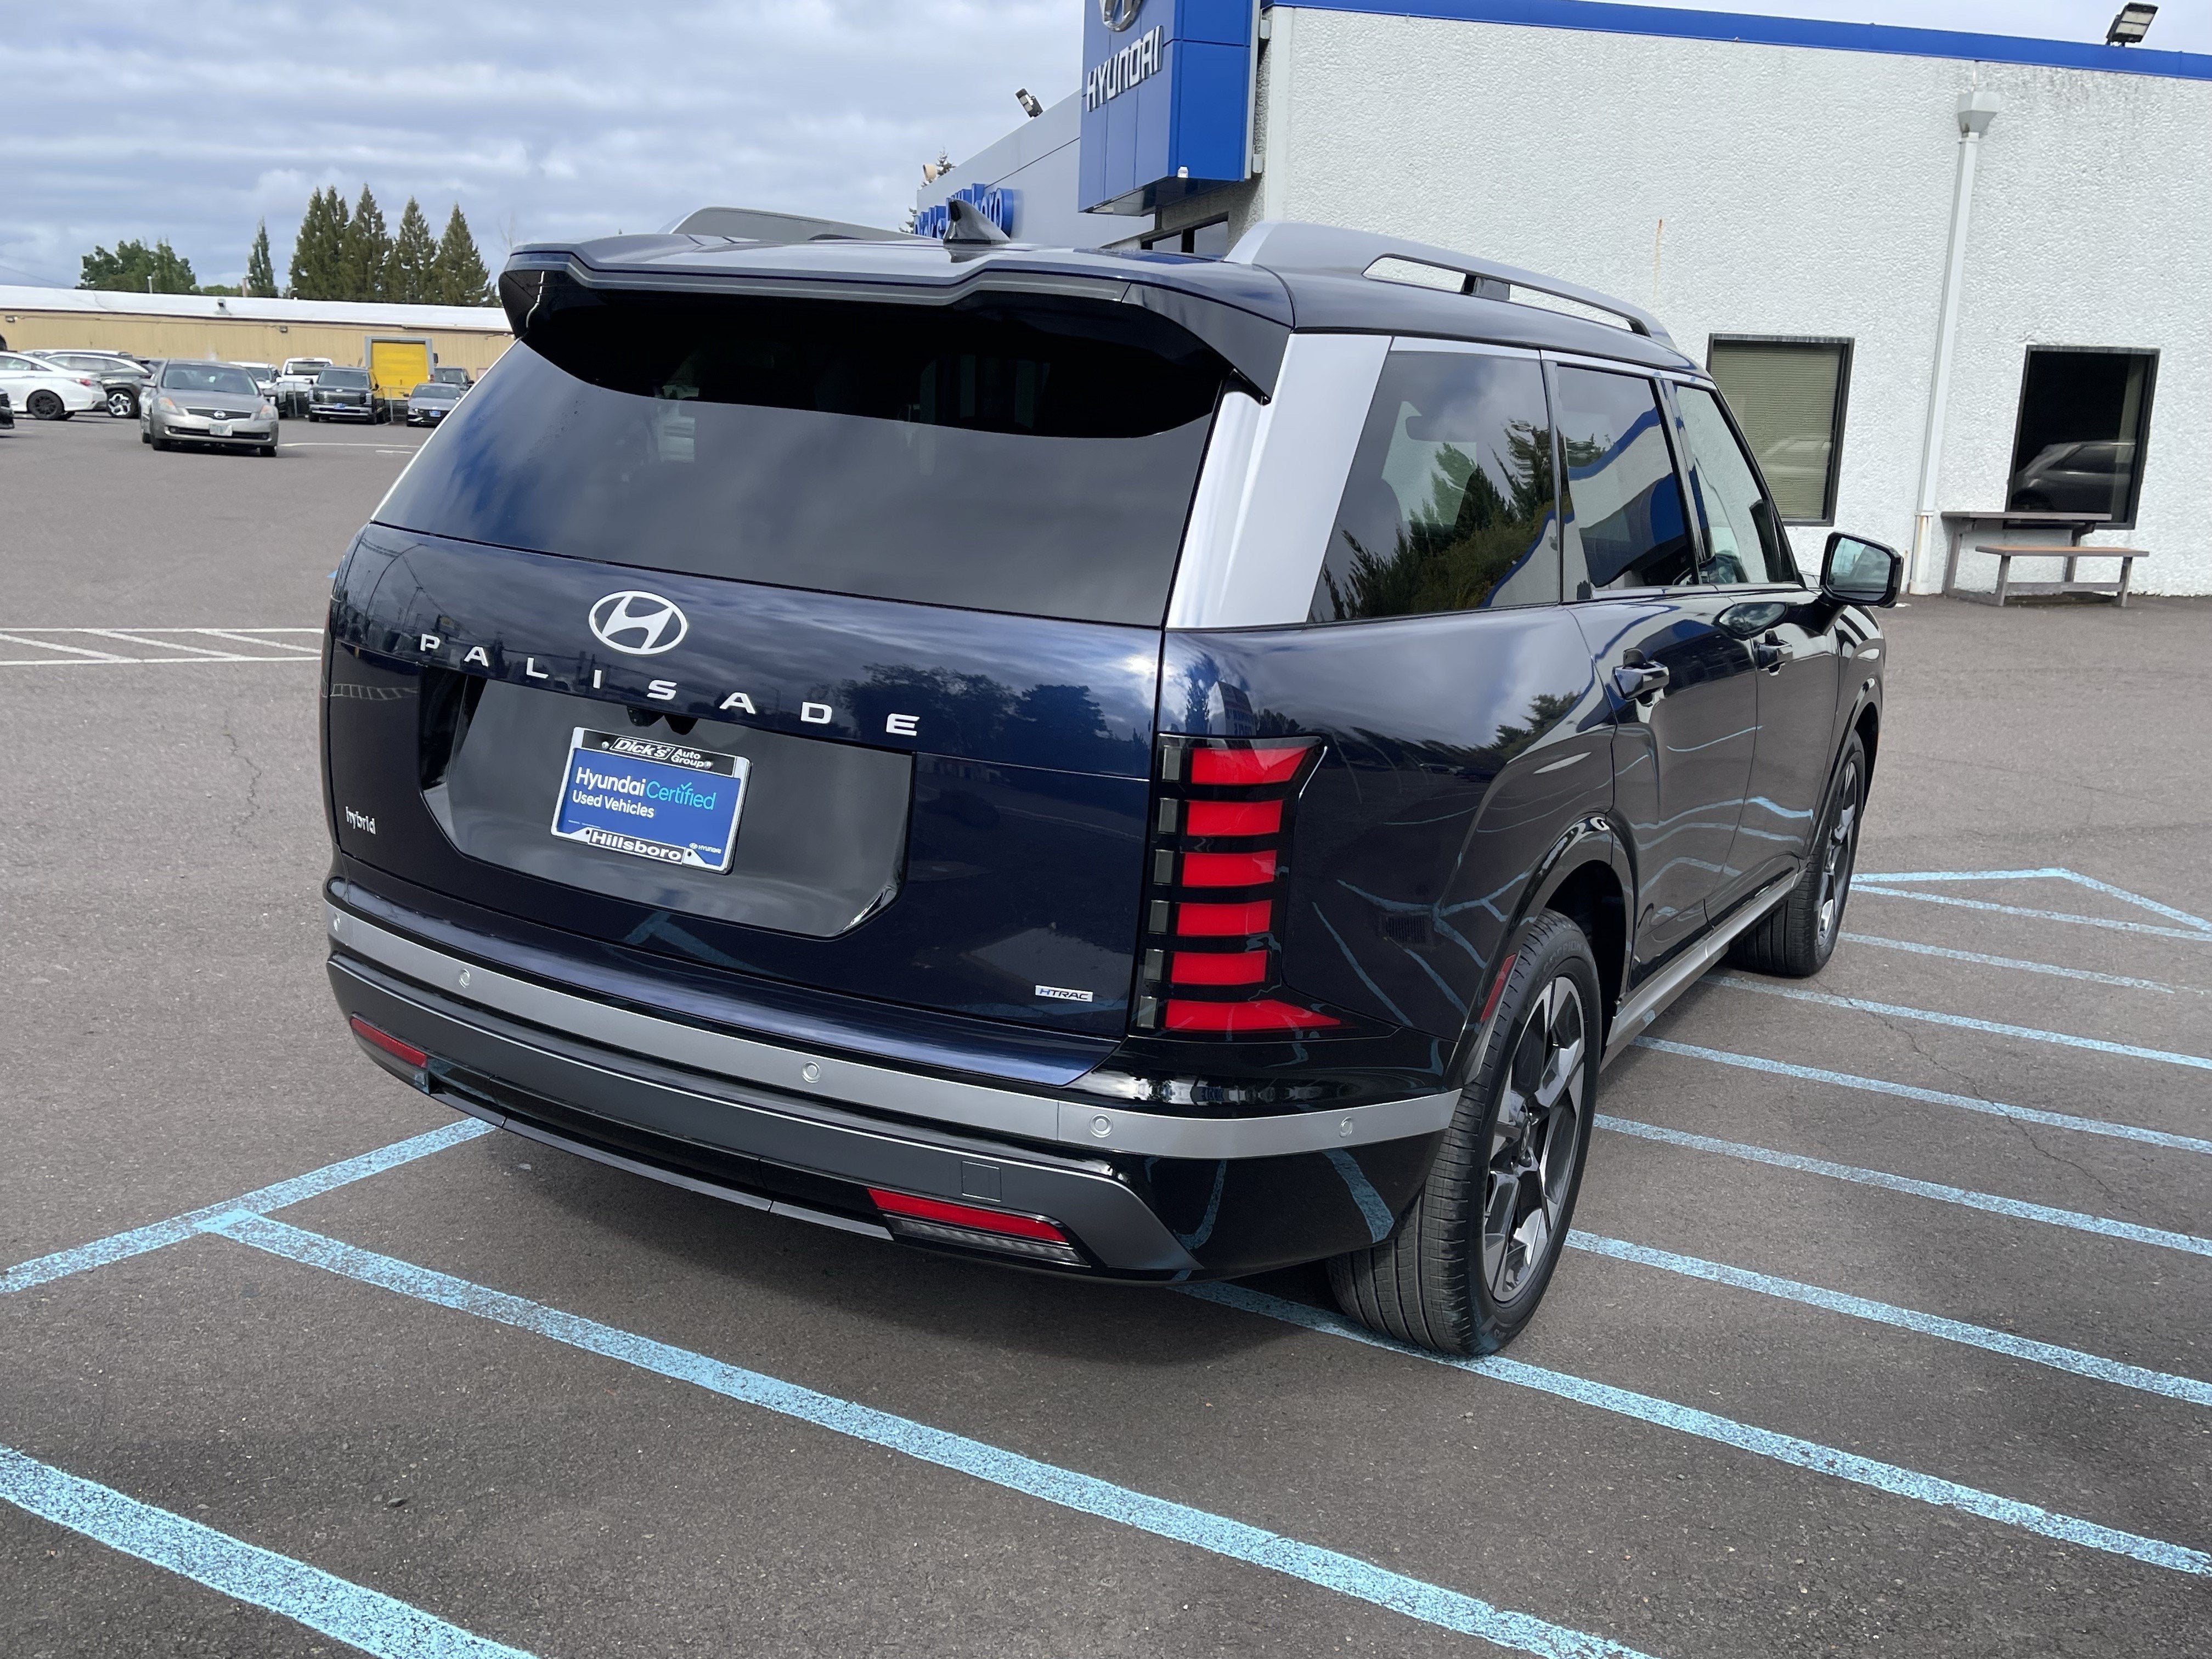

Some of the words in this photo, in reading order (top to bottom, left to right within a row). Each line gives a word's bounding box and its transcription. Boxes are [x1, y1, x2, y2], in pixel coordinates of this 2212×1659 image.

[1087, 25, 1163, 112] HYUNDAI
[420, 634, 920, 736] PALISADE
[670, 755, 704, 768] Group
[674, 749, 701, 760] Auto
[575, 766, 646, 796] Hyundai
[646, 780, 717, 810] Certified
[572, 789, 603, 808] Used
[605, 795, 655, 819] Vehicles
[591, 831, 682, 860] Hillsboro
[1039, 988, 1089, 1000] HTRAC
